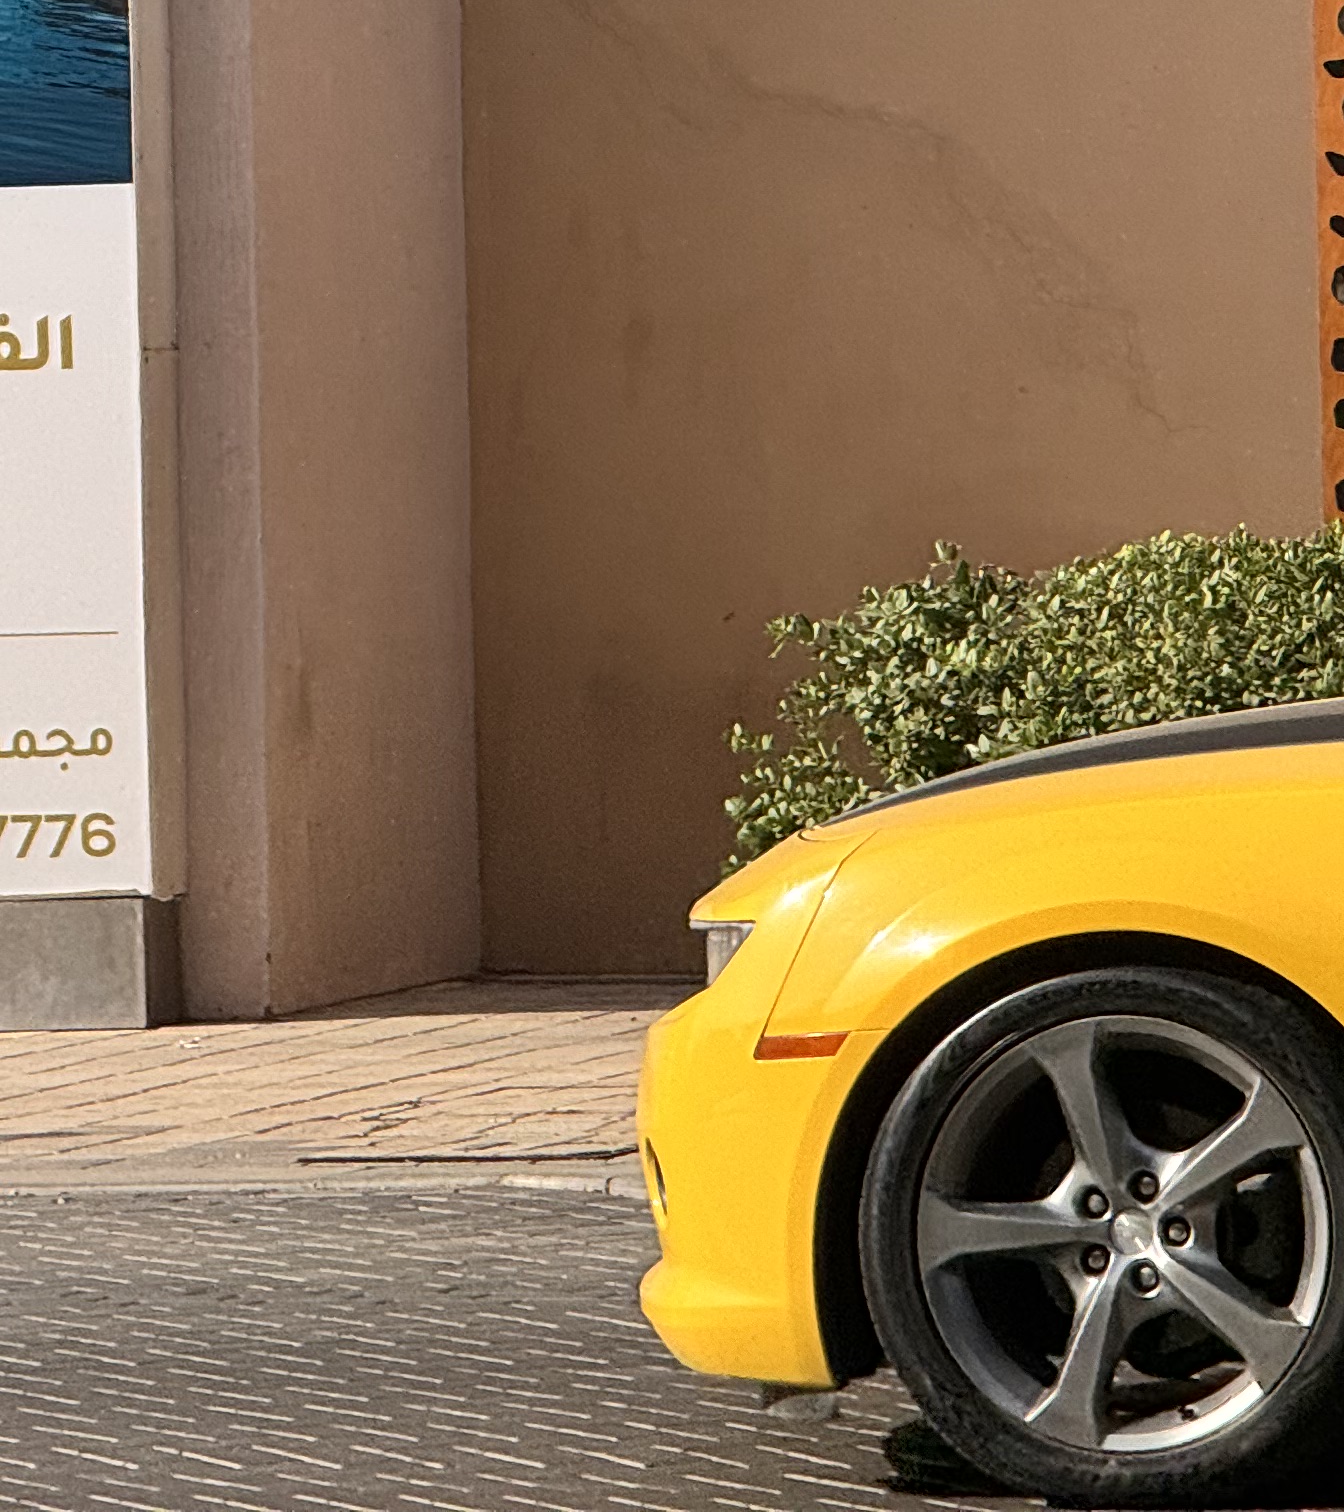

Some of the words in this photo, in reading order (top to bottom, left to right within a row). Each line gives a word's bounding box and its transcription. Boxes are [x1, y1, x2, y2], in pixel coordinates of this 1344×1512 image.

[0, 313, 74, 371] الف
[0, 727, 114, 772] مجم
[0, 812, 117, 859] 776
